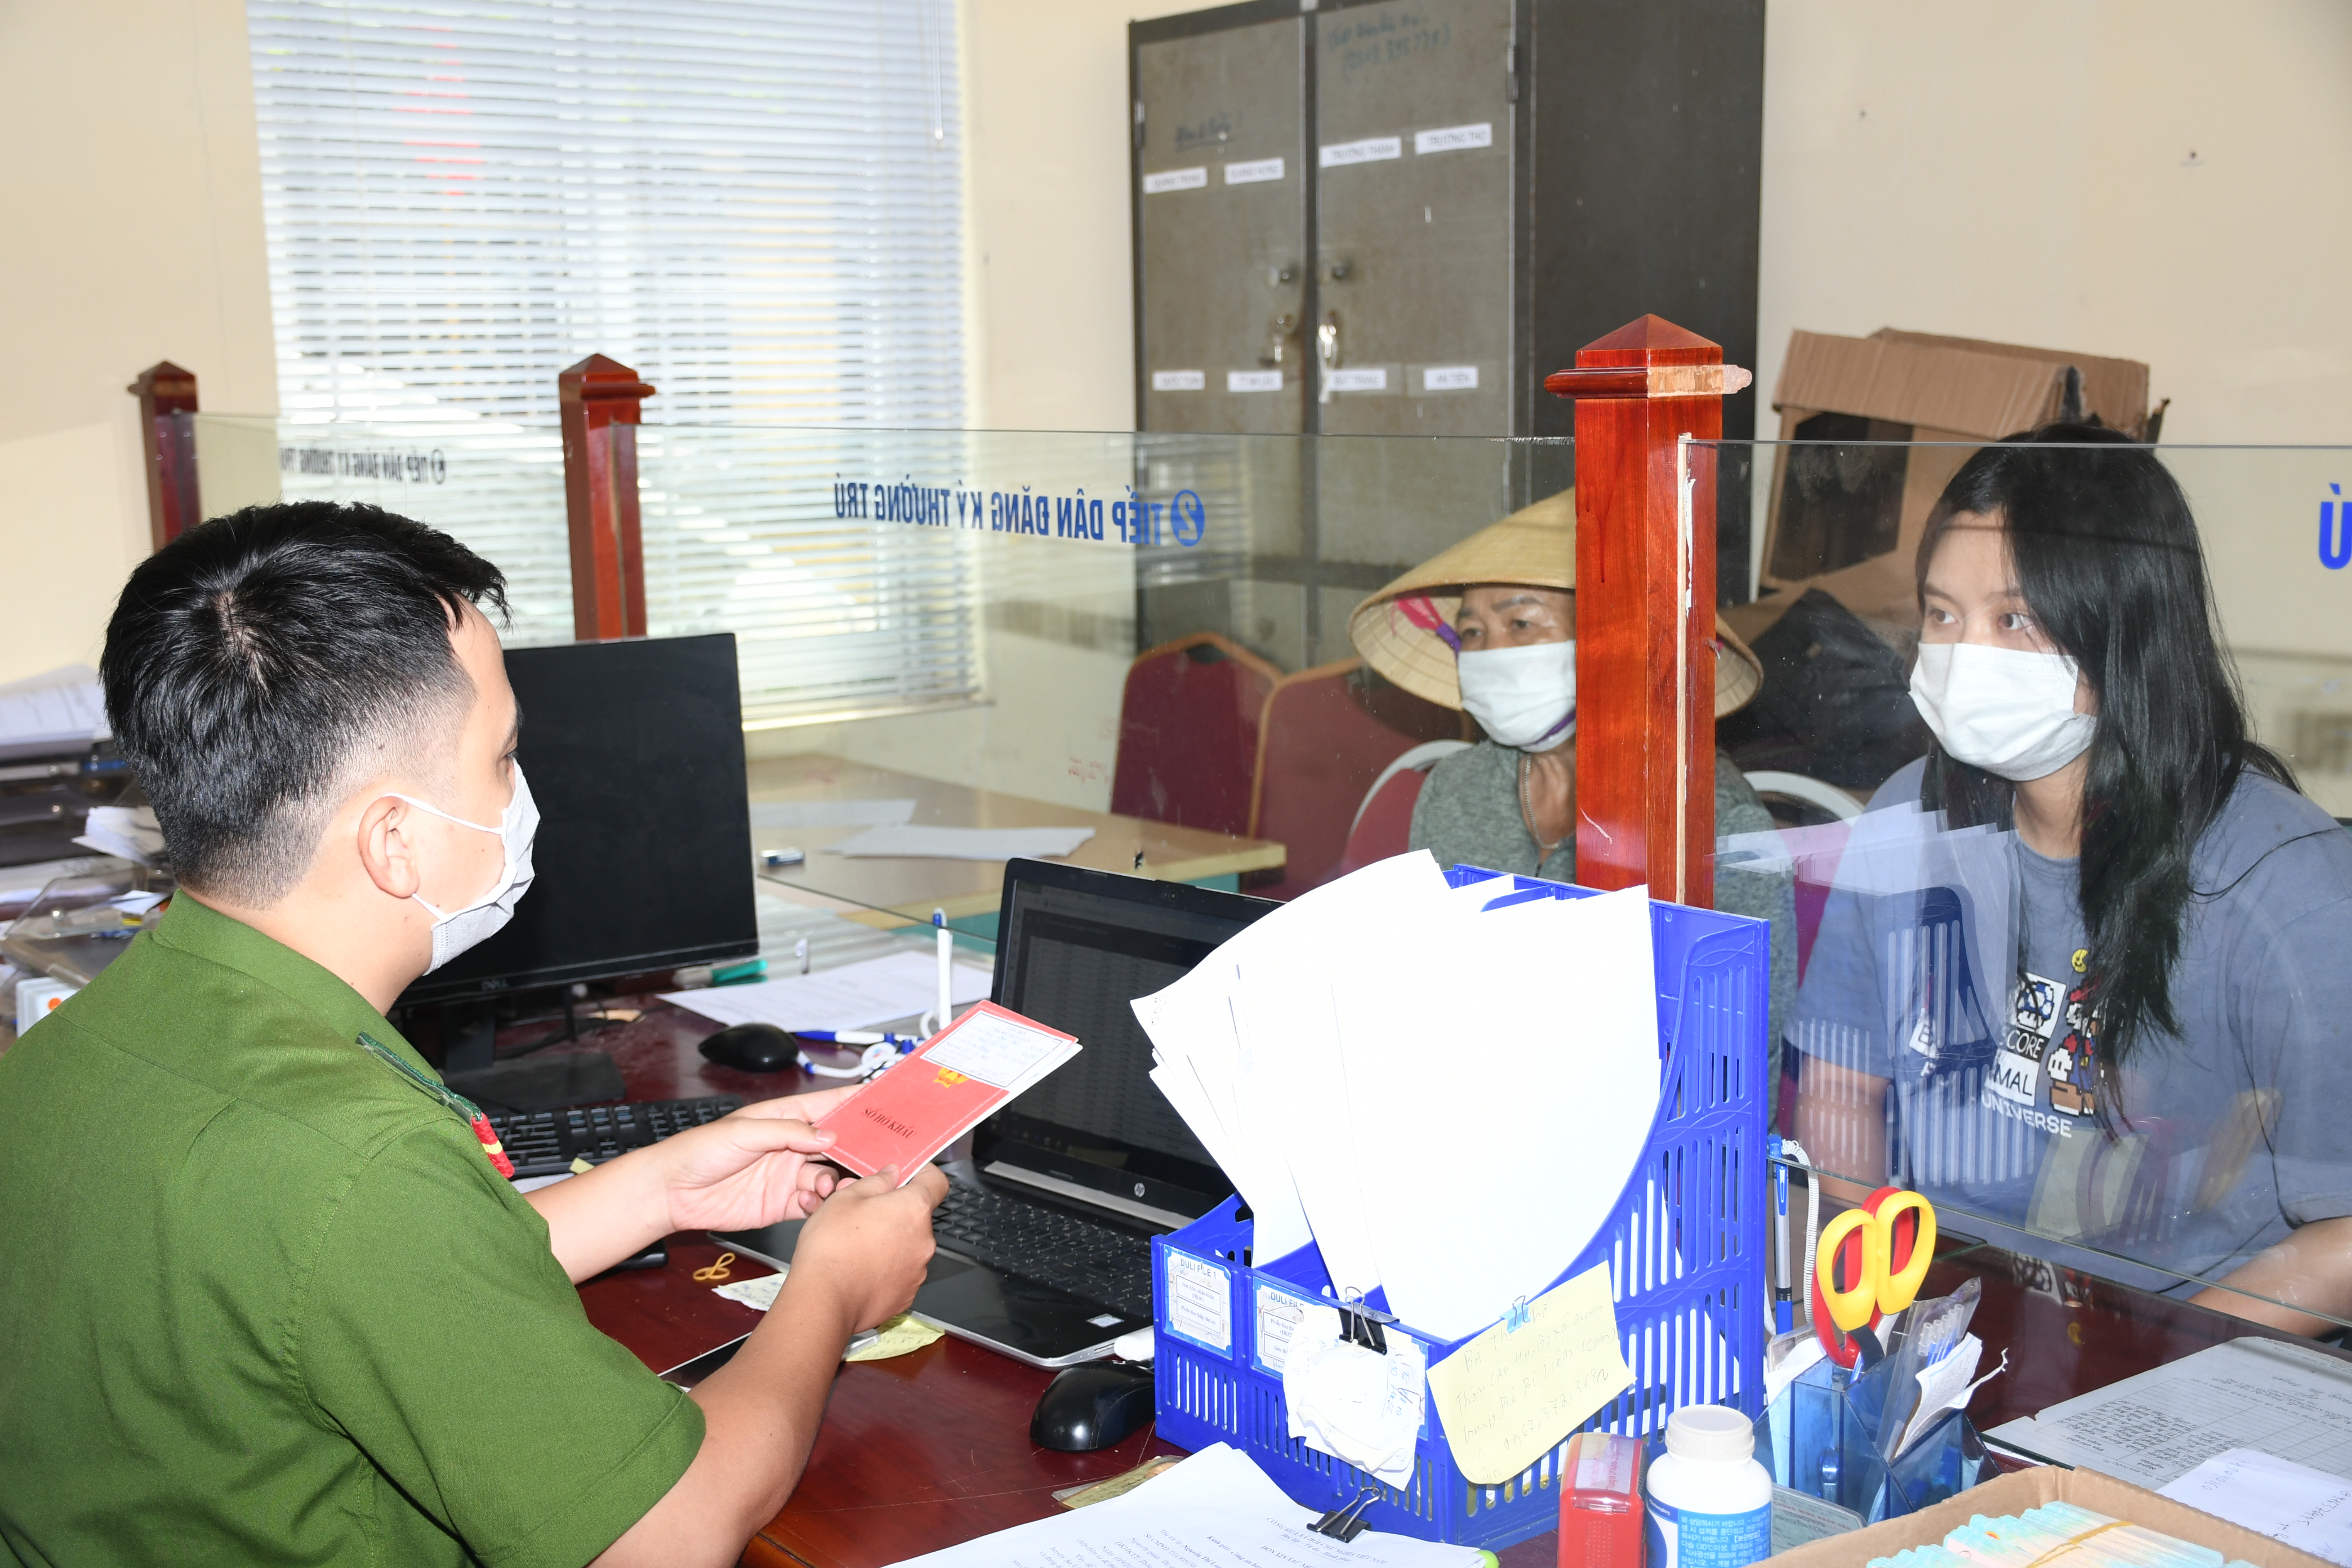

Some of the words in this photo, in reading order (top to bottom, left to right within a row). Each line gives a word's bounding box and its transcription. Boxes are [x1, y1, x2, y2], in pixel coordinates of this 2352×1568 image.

[2006, 1029, 2045, 1059] CORE
[1992, 1063, 2033, 1097] MAL
[1981, 1089, 2073, 1139] UNIVERSE
[1181, 1258, 1195, 1271] DULI
[1271, 1291, 1288, 1306] DULI
[1690, 1518, 1720, 1527] 상담하시기
[1722, 1518, 1746, 1527] 바랍니다.
[1681, 1532, 1700, 1542] 하시기
[1703, 1535, 1730, 1544] 바랍니다.
[1698, 1527, 1718, 1536] 섭취를
[1720, 1527, 1744, 1536] 중단하고
[1681, 1540, 1694, 1549] 다습
